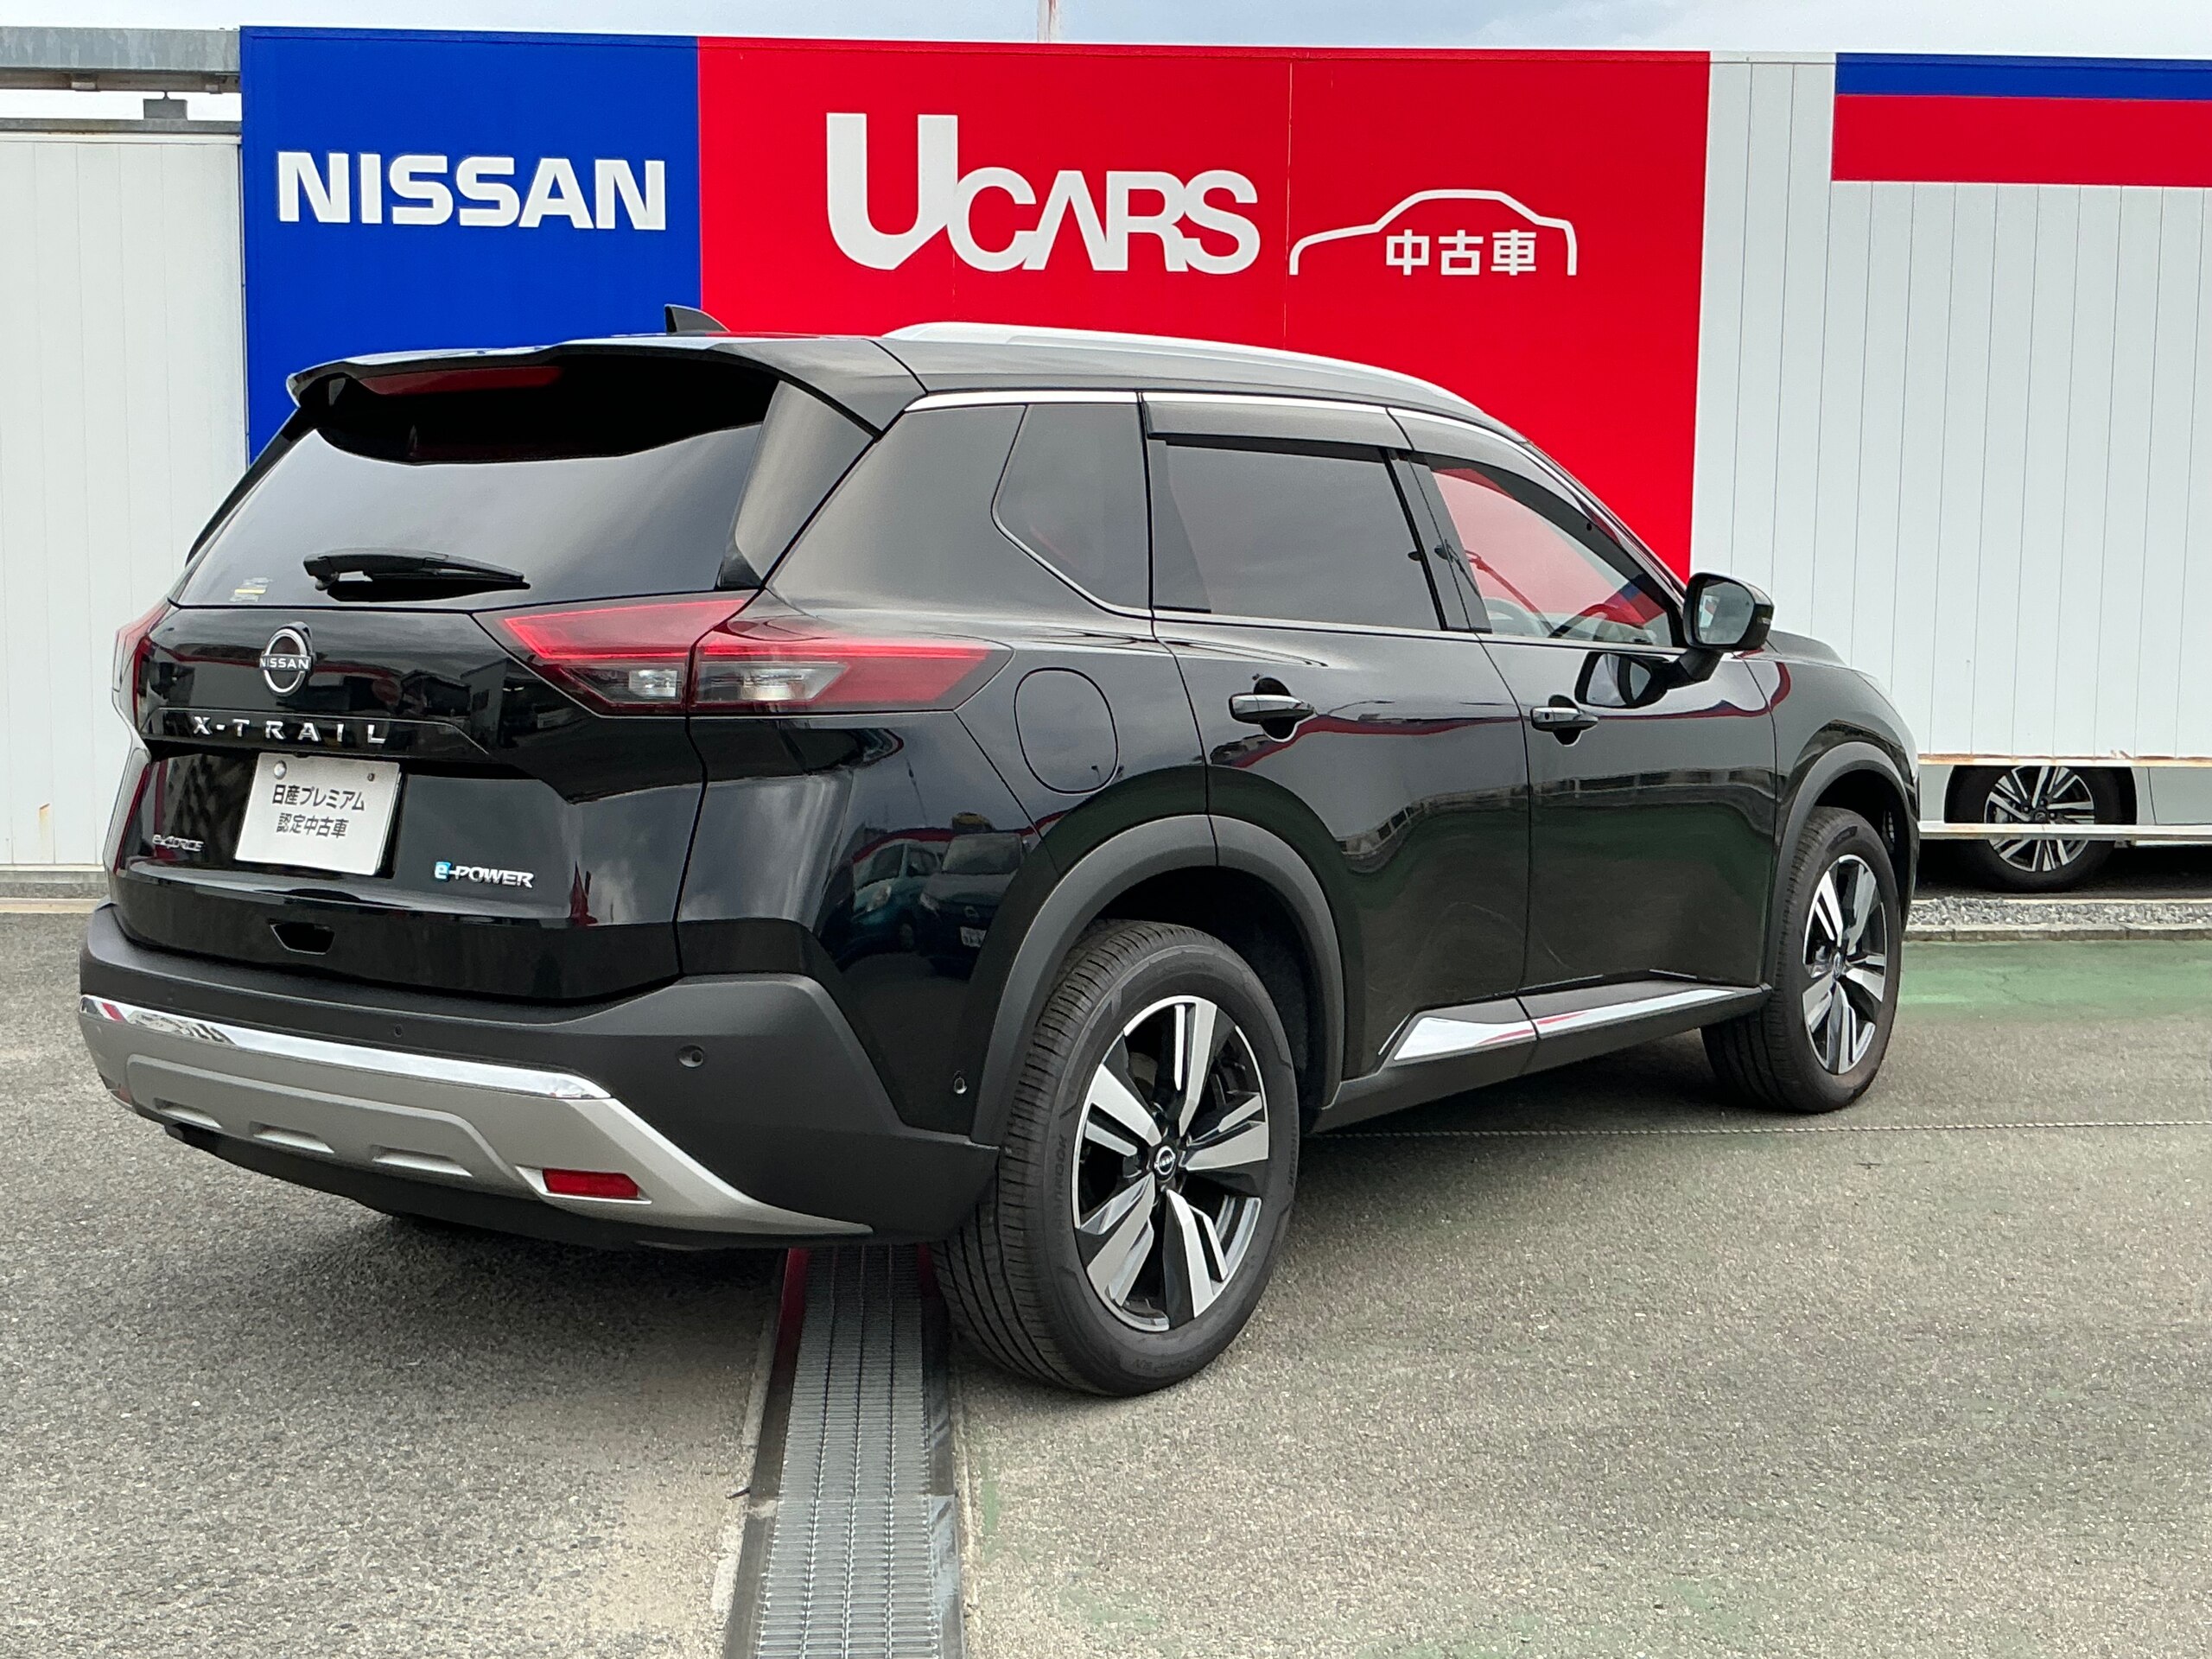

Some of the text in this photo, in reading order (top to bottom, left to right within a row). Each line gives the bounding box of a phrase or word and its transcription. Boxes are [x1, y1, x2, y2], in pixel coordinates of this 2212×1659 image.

[277, 150, 665, 231] NISSAN
[1385, 229, 1537, 276] 中古車
[259, 657, 309, 670] NISSAN
[193, 715, 386, 745] X-TRAIL
[271, 783, 365, 812] 日産プレミアム
[275, 811, 350, 839] 認定中古車
[434, 861, 535, 889] e-POWER
